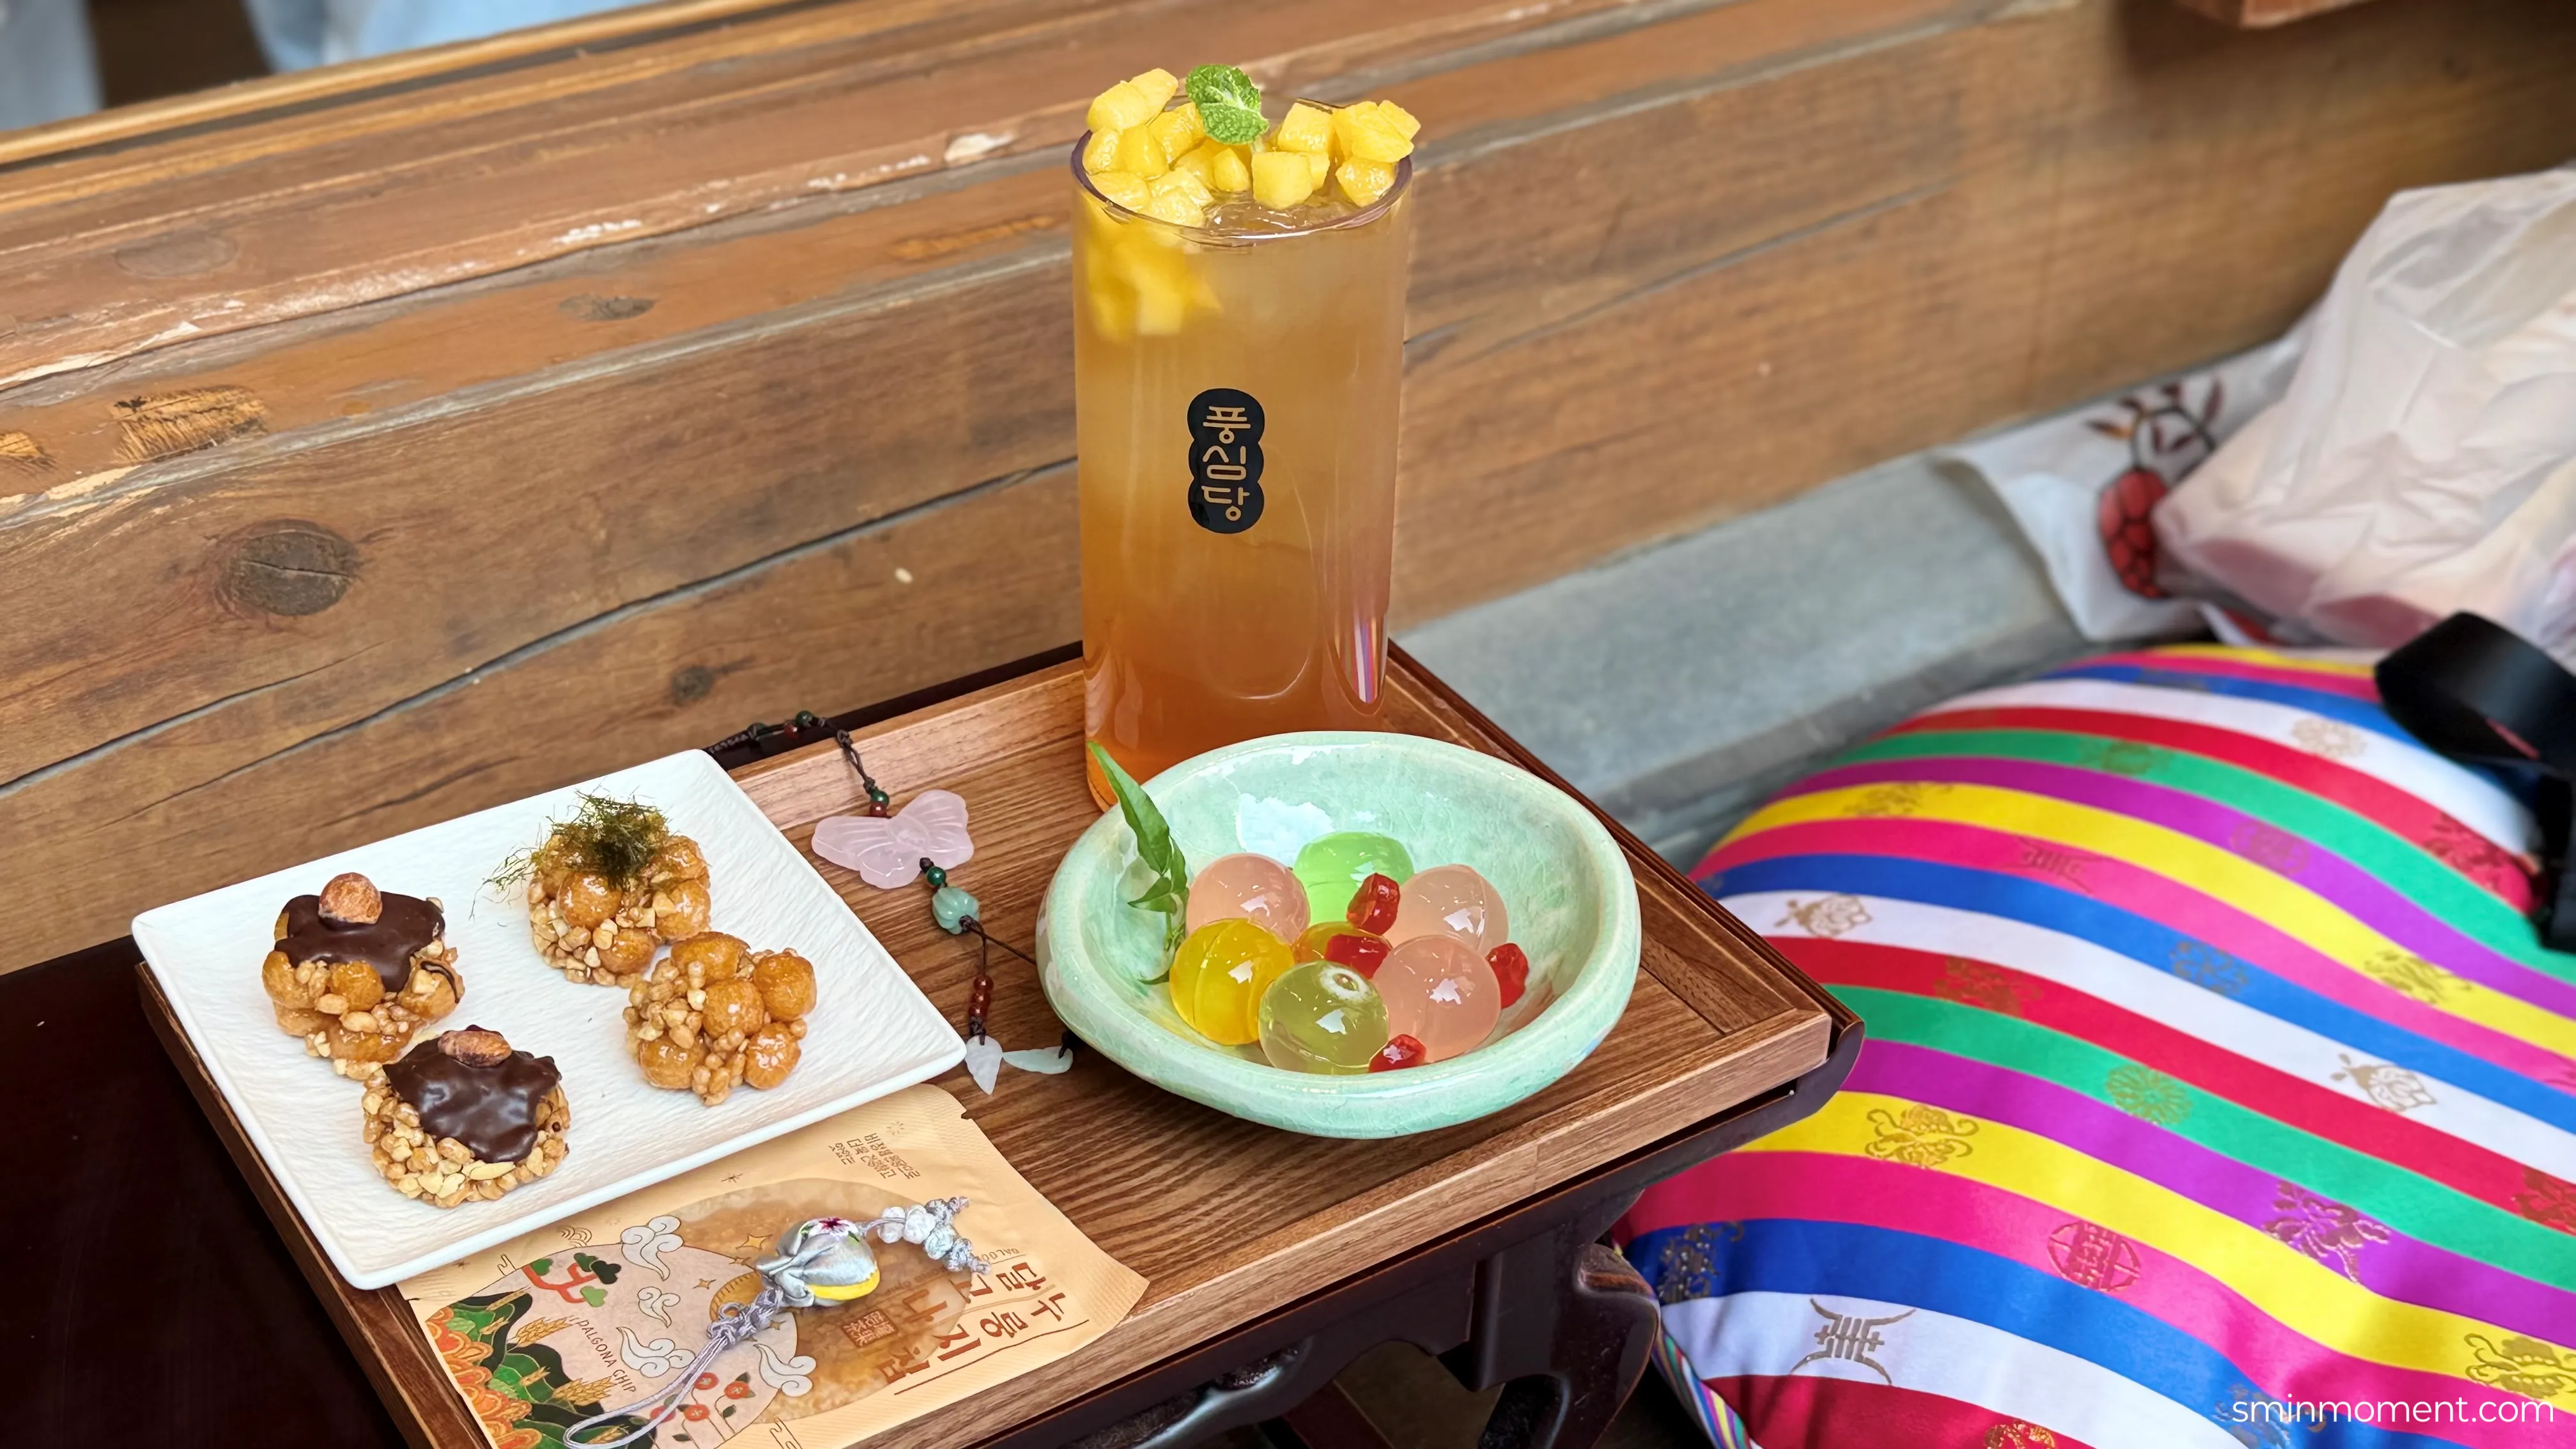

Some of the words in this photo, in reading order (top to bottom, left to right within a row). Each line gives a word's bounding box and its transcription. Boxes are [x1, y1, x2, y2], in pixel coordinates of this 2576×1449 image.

[1201, 406, 1251, 521] 풍심당
[577, 1319, 617, 1367] DALGONA
[612, 1369, 636, 1392] CHIP
